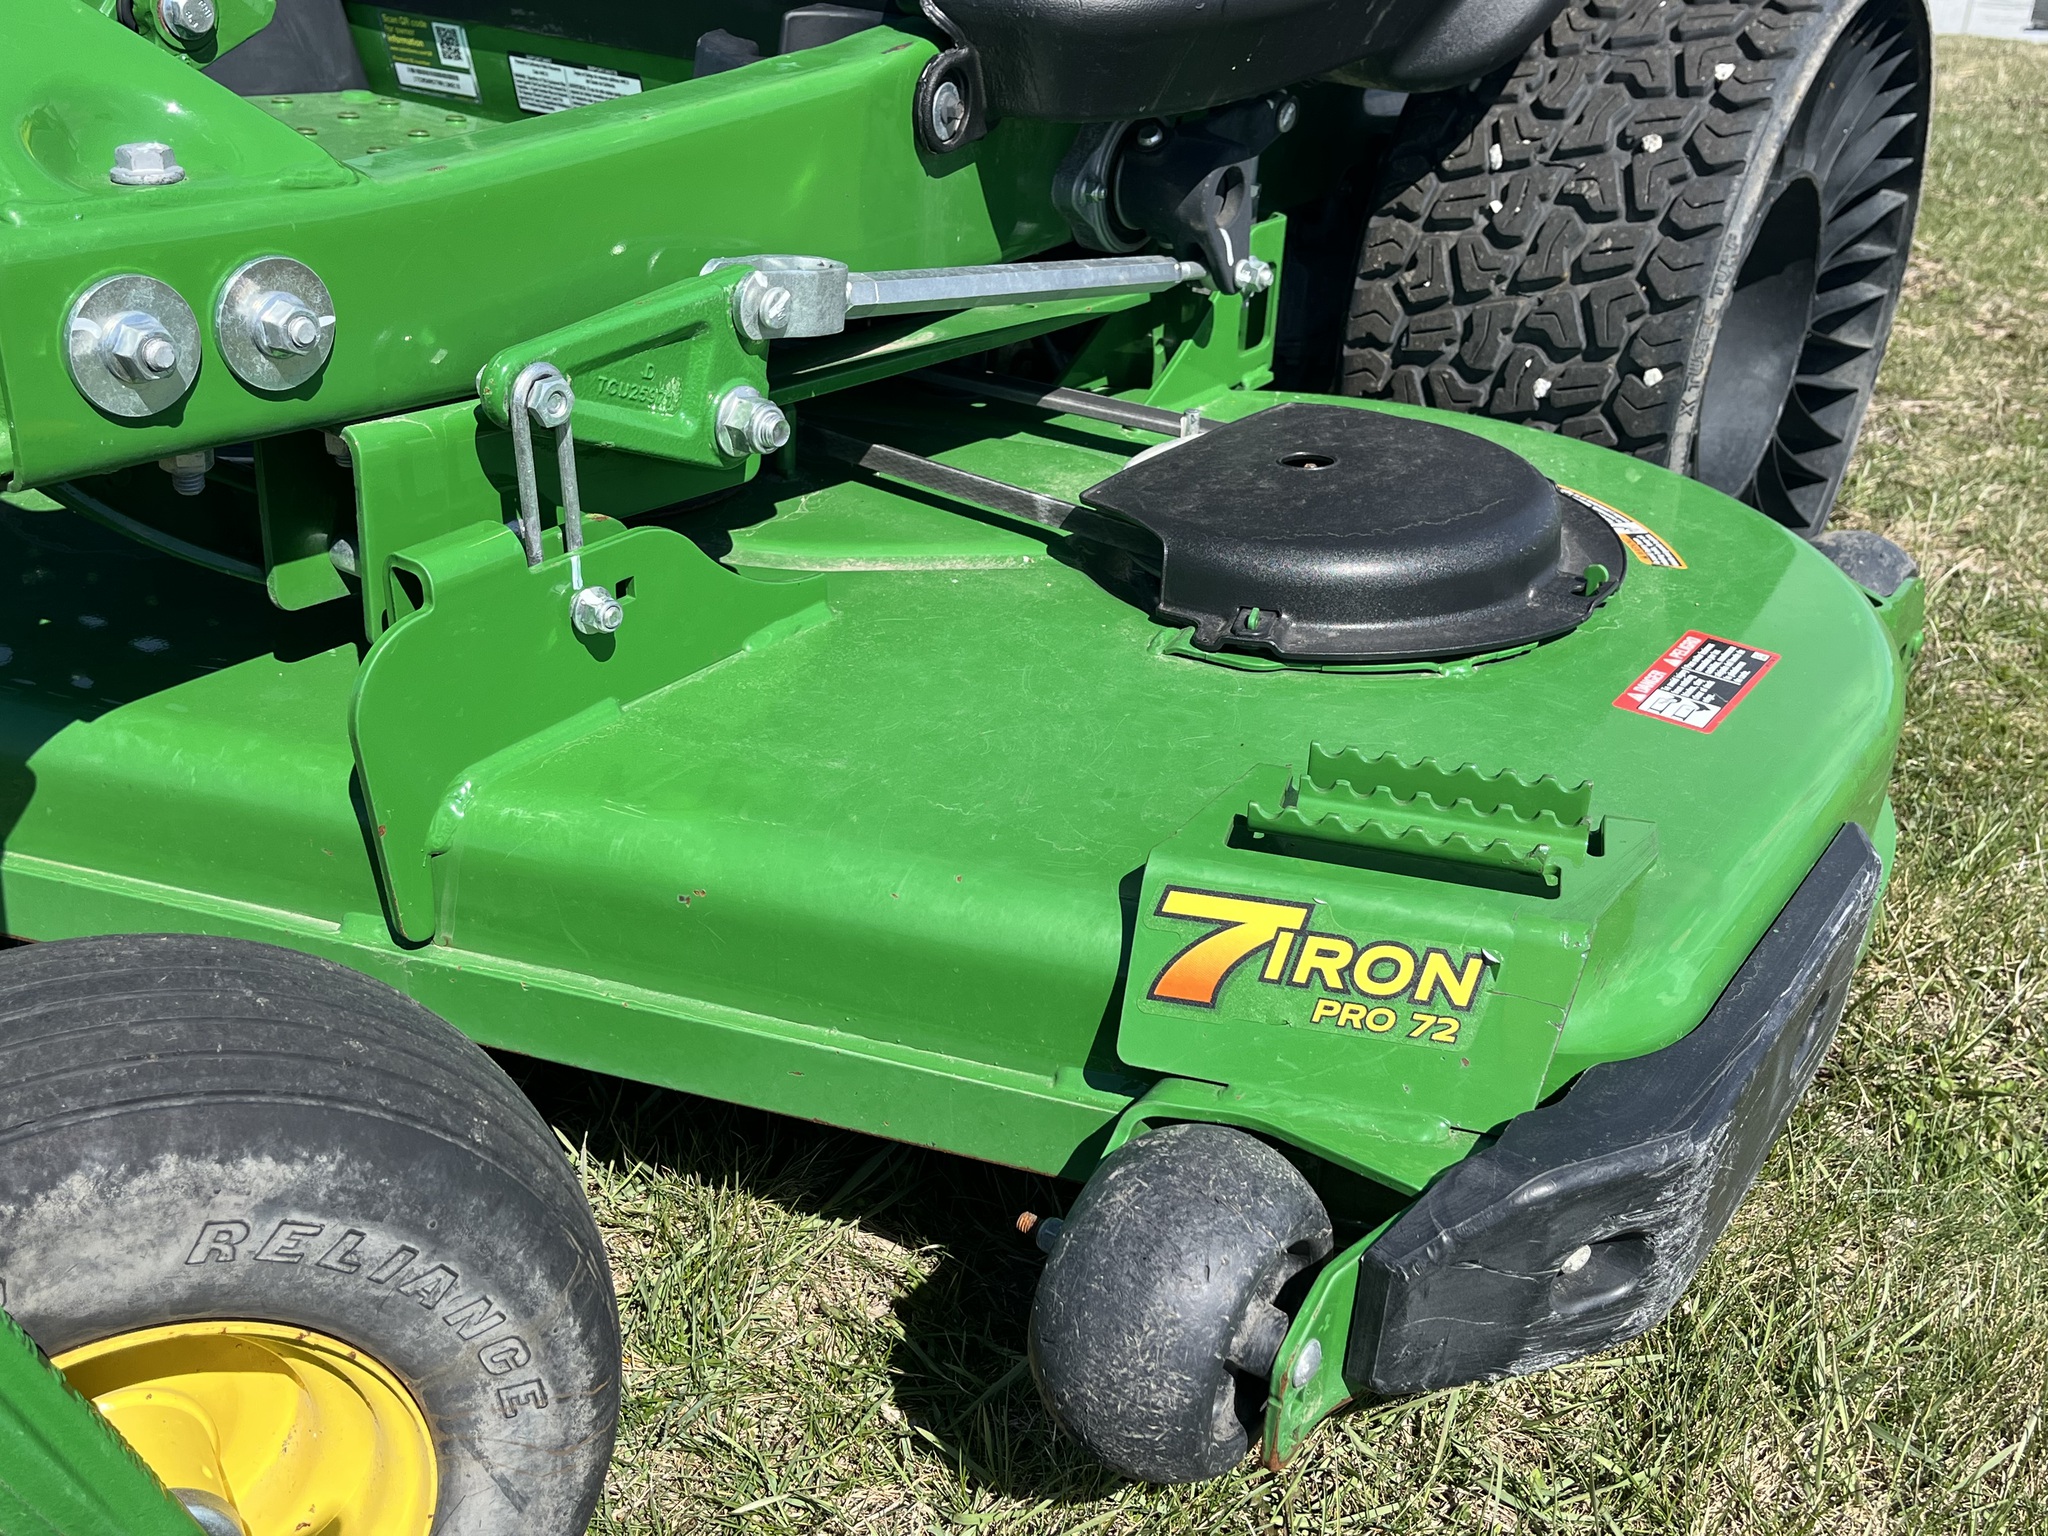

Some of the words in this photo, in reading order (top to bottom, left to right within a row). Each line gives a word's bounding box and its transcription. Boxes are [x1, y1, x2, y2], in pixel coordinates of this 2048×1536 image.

[1668, 635, 1703, 660] PELIGRO
[1632, 669, 1667, 693] DANGER
[1310, 998, 1398, 1034] PRO
[1407, 1013, 1462, 1046] 72
[185, 1219, 549, 1419] RELIANCE
